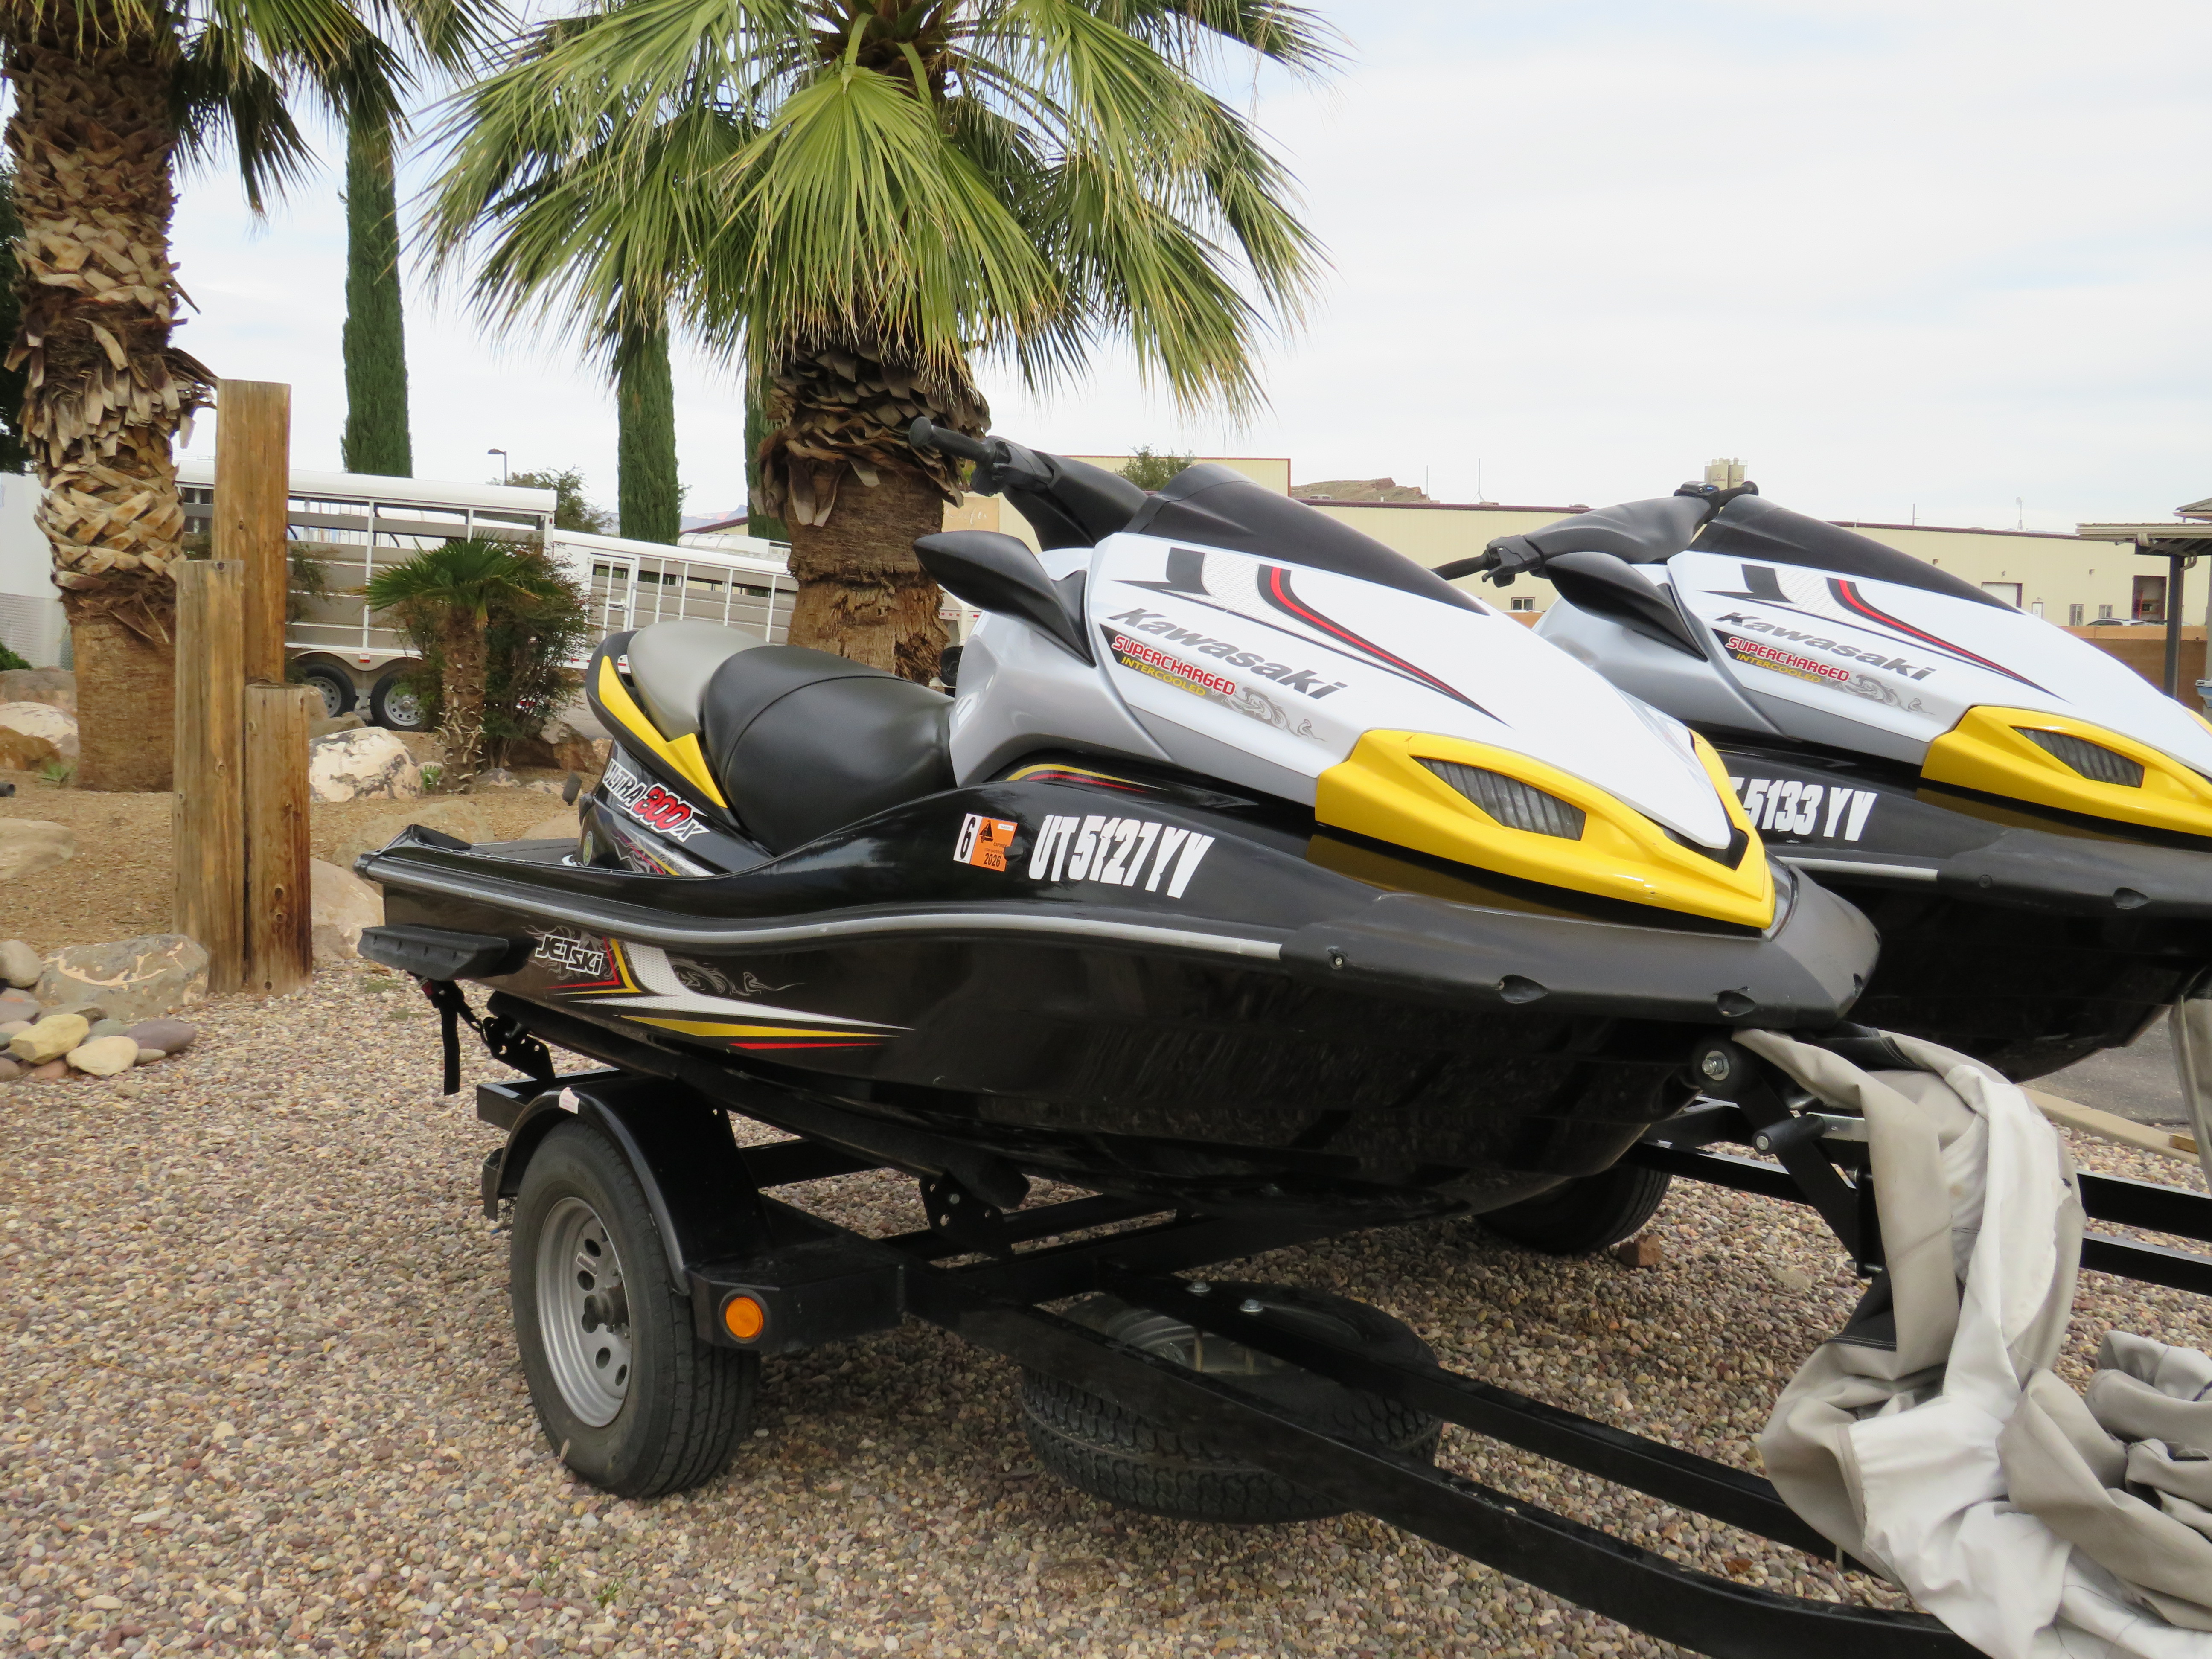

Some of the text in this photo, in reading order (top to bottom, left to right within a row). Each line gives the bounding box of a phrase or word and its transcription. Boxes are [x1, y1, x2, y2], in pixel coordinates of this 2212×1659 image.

[1107, 608, 1348, 700] Kawasaki
[1112, 636, 1236, 696] SUPERCHARGED
[1714, 612, 1936, 680] Kawasaki
[1726, 637, 1849, 681] SUPERCHARGED
[1737, 654, 1820, 681] INTERCOOLED
[1121, 656, 1206, 696] INTERCOOLED
[602, 758, 647, 807] ULTRA
[1743, 779, 1877, 841] 5133 YV
[960, 817, 976, 859] 6
[984, 853, 1001, 867] 2026
[1145, 826, 1215, 899] YV
